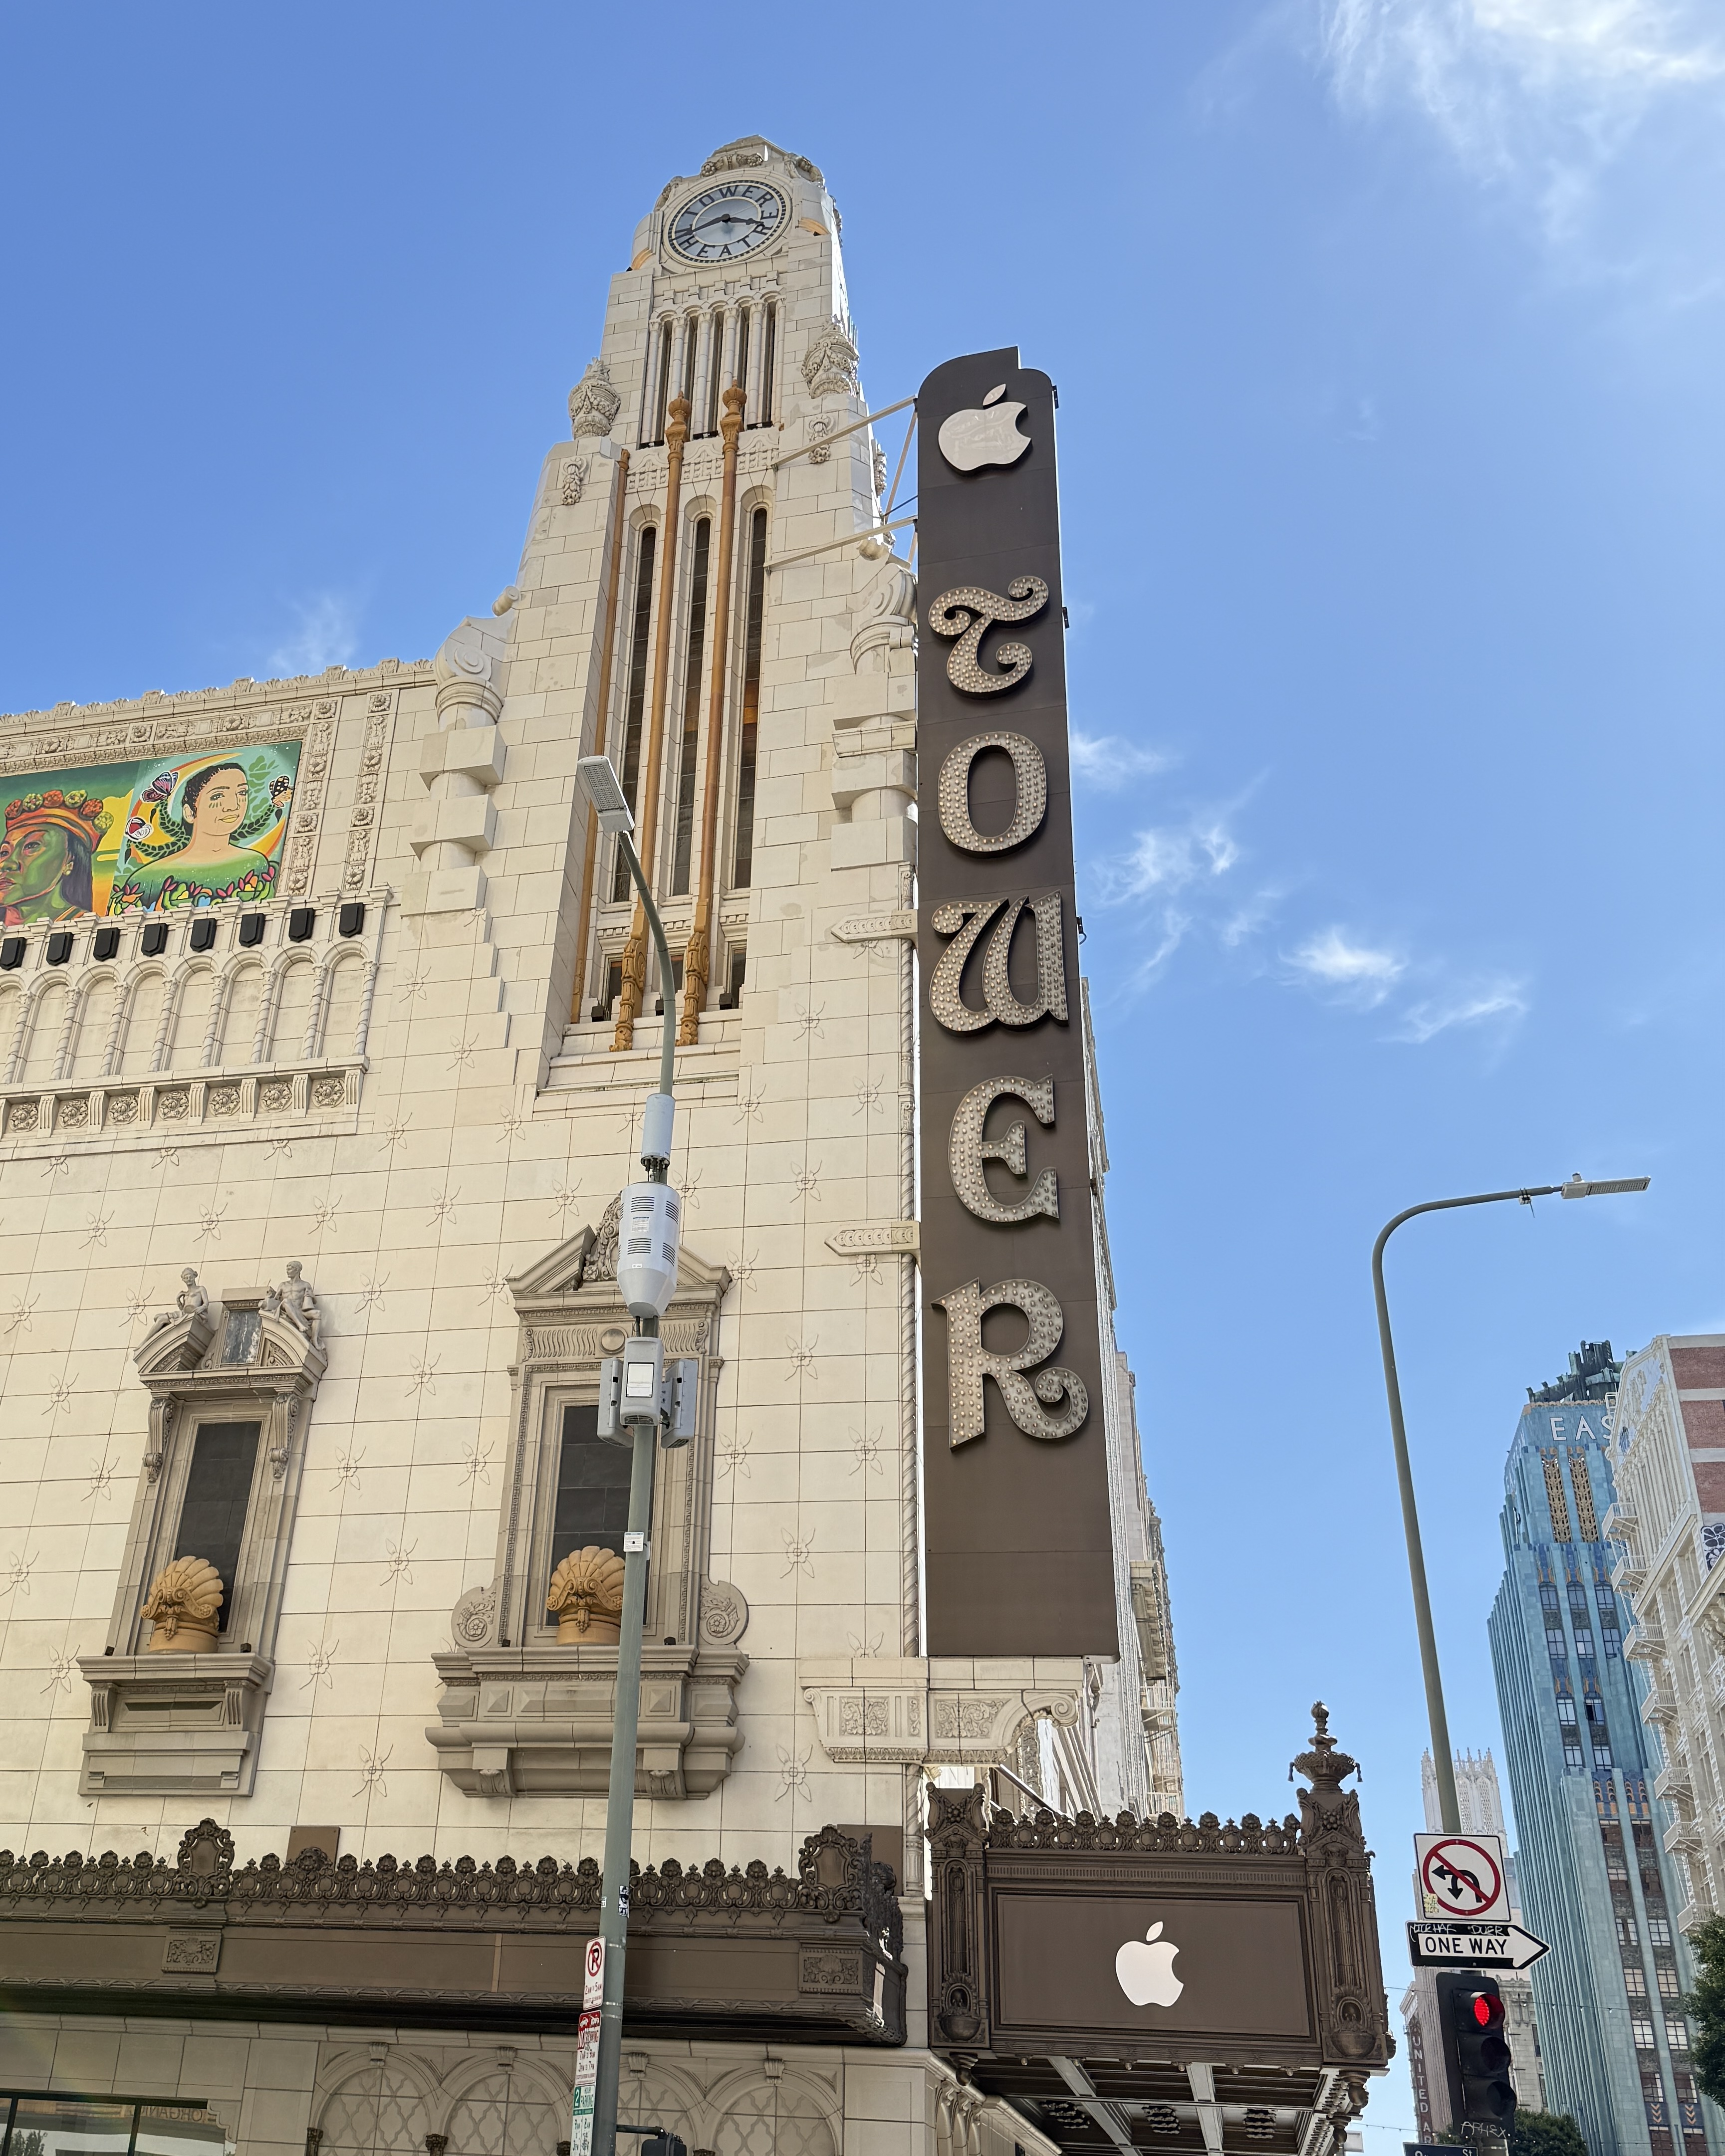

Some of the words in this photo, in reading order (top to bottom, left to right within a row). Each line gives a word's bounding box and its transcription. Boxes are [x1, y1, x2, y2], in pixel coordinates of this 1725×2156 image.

[682, 185, 774, 216] TOWER
[928, 575, 1088, 1451] TOWER
[1425, 1937, 1464, 1953] ONE
[1469, 1938, 1507, 1955] WAY
[1413, 2036, 1428, 2113] UNITED
[575, 2089, 579, 2107] 2
[1461, 2121, 1506, 2140] APHEX
